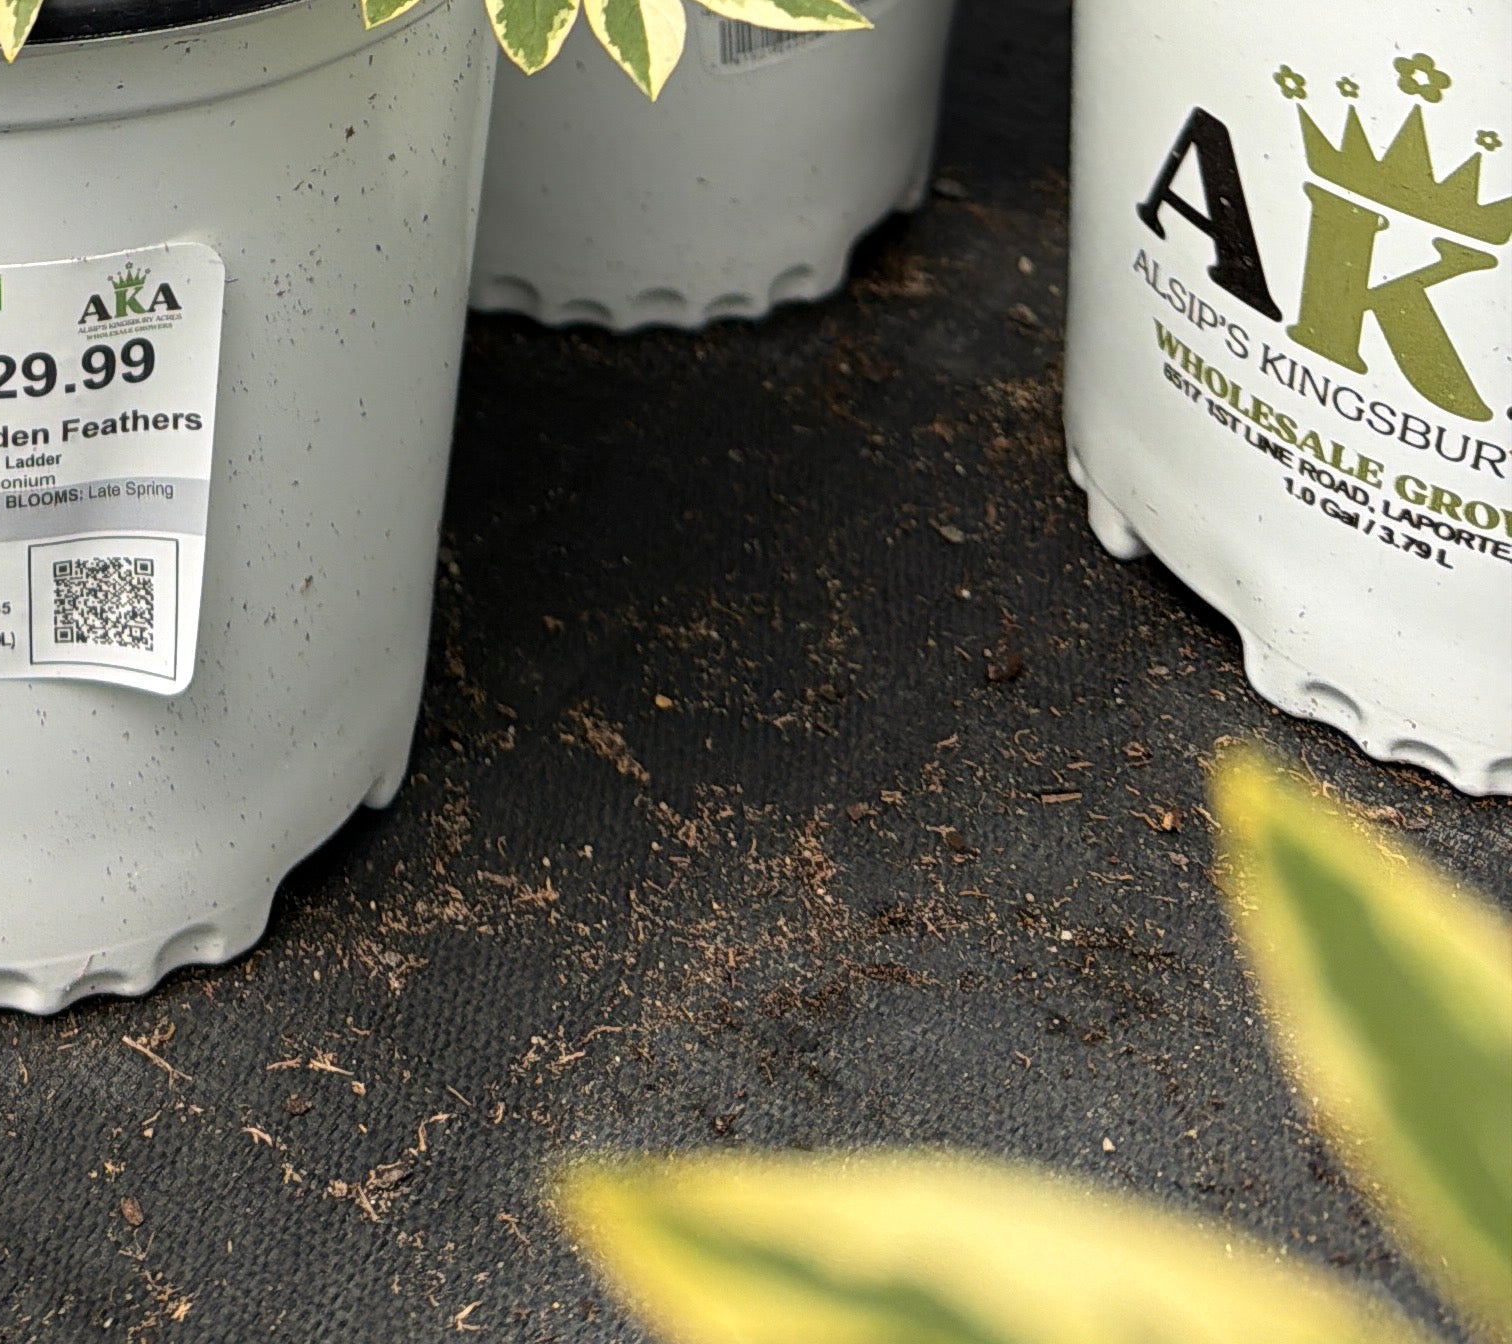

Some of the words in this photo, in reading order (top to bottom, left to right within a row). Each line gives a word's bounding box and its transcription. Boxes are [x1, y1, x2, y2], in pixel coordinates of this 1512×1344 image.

[78, 282, 183, 325] AKA
[1135, 106, 1512, 423] AK
[1133, 248, 1250, 360] ALSIP'S
[1259, 342, 1512, 480] KINGSBUR
[5, 452, 62, 470] Ladder
[62, 410, 203, 443] Feathers
[1153, 315, 1385, 490] WHOLESALE
[1394, 474, 1512, 539] GRO
[1163, 361, 1202, 403] 6517
[1205, 397, 1242, 434] 1ST
[1244, 424, 1295, 470] LINE
[5, 488, 84, 509] BLOOMS:
[88, 483, 121, 500] Late
[126, 480, 175, 500] Spring
[1284, 475, 1316, 506] 1.0
[1320, 497, 1361, 531] Gal
[1363, 519, 1376, 536] /
[1378, 524, 1433, 560] 3.79
[1437, 548, 1454, 570] L
